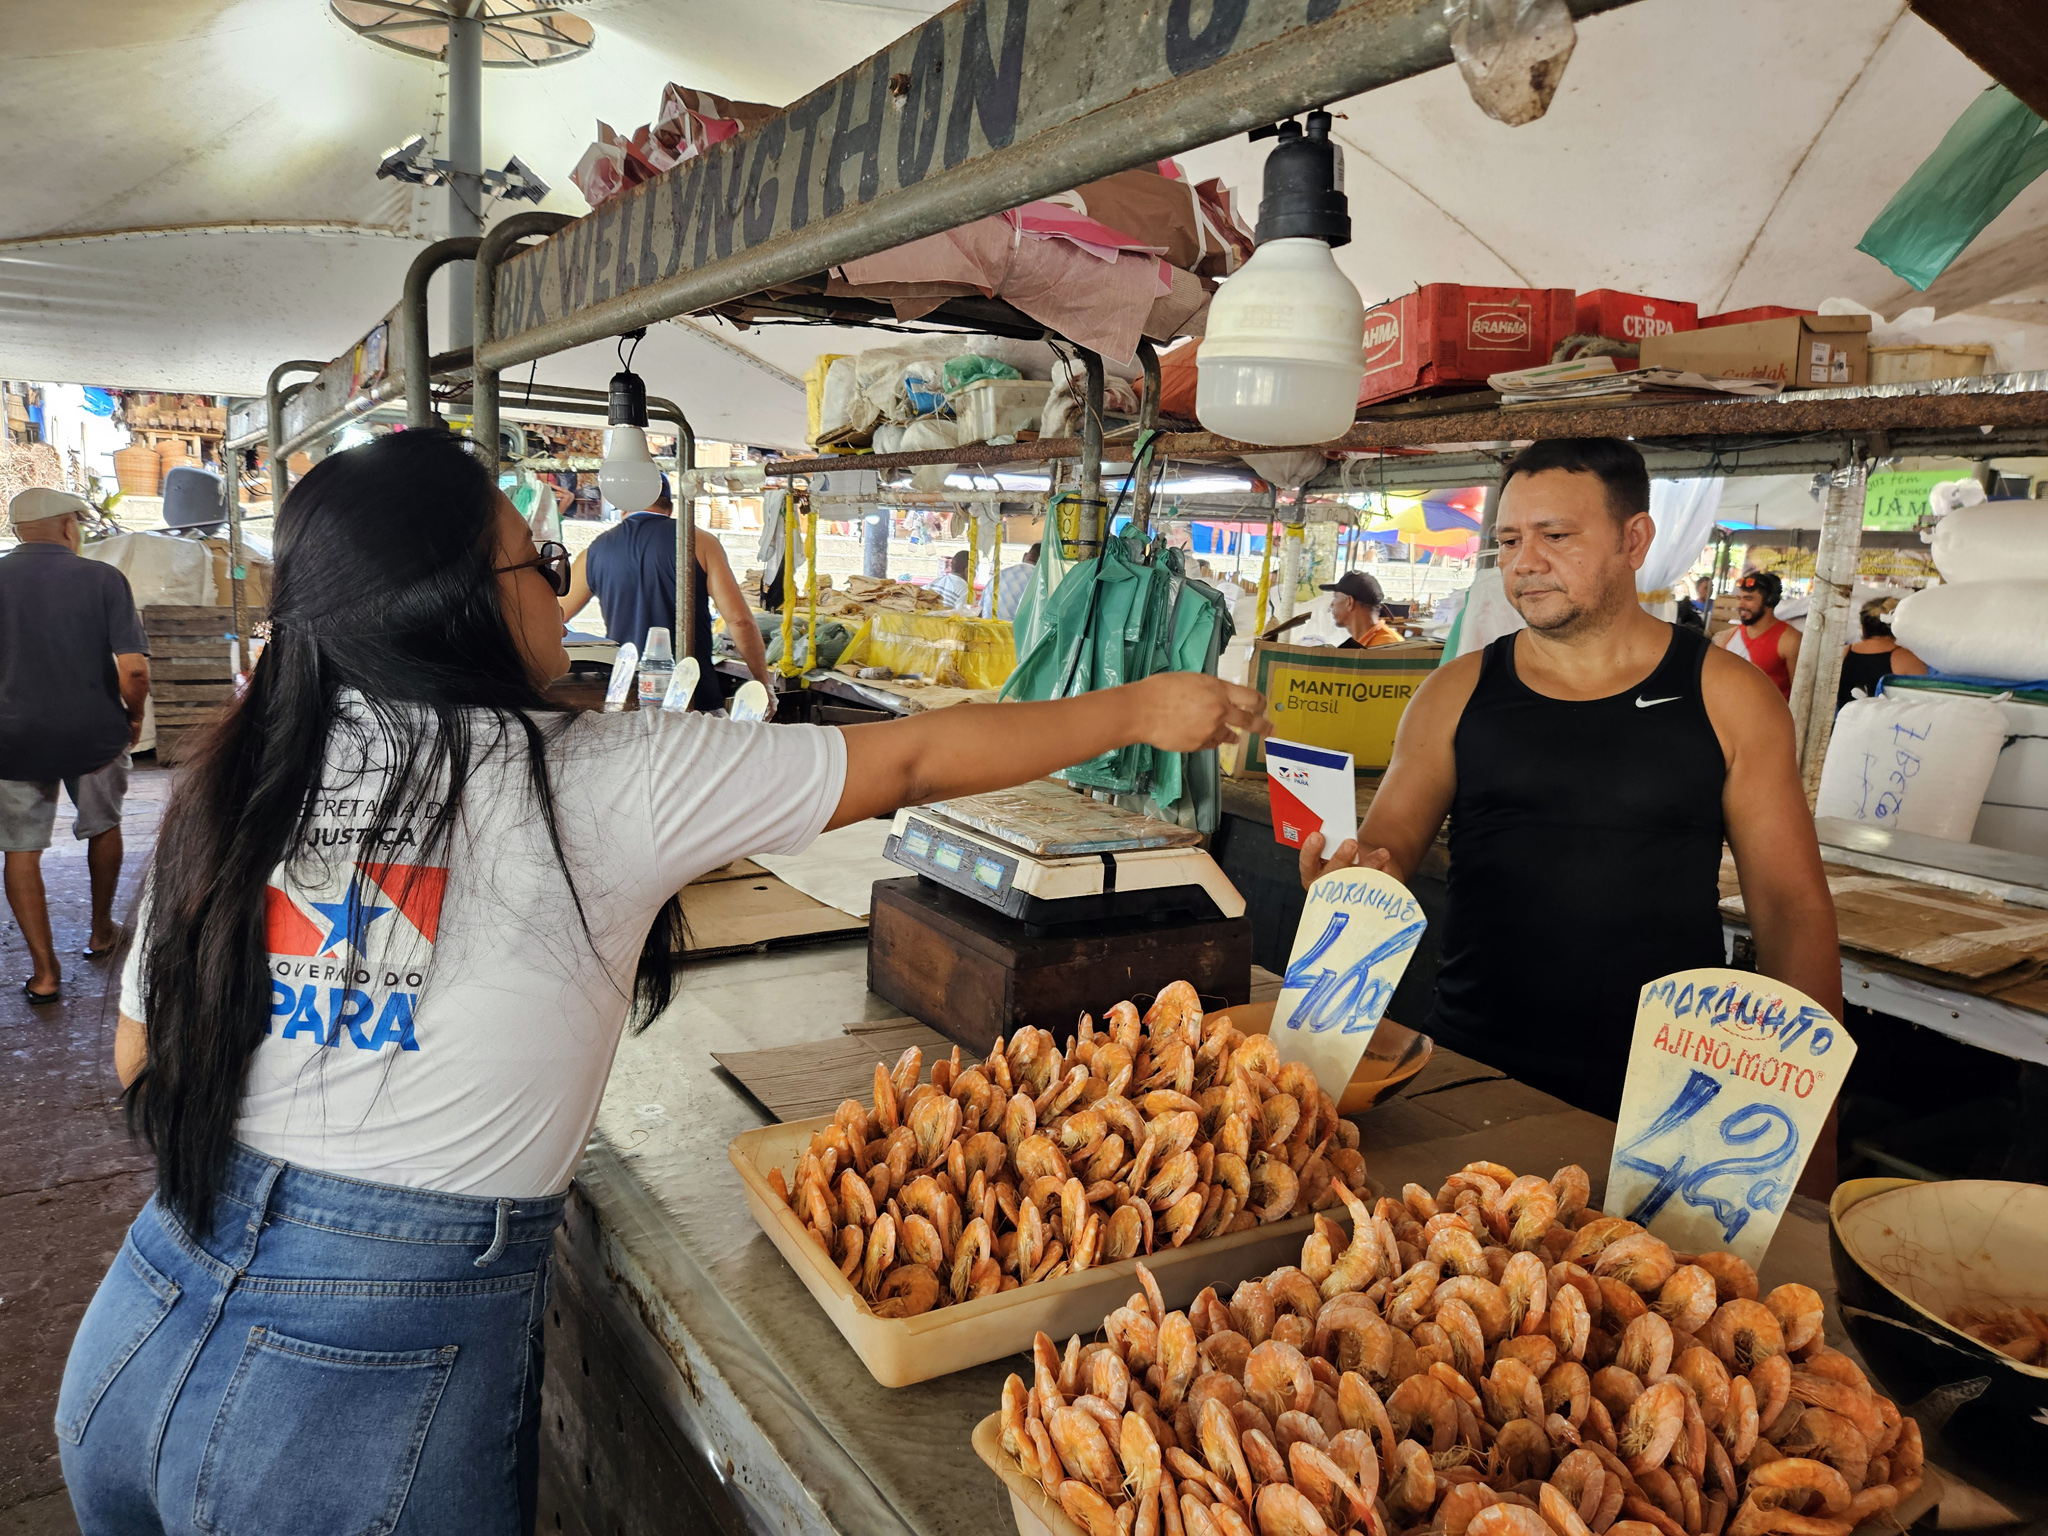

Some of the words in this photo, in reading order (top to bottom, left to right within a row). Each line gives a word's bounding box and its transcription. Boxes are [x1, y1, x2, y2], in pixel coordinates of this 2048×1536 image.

[498, 246, 549, 341] BOX
[1361, 319, 1400, 350] AHMA
[1471, 320, 1527, 335] BRAHMA
[1622, 314, 1675, 338] CERPA
[1868, 496, 1935, 518] JAM
[1289, 678, 1420, 703] MANTIQUEIR
[1287, 695, 1339, 714] Brasil
[268, 961, 370, 985] OVERNO
[384, 971, 423, 988] DO
